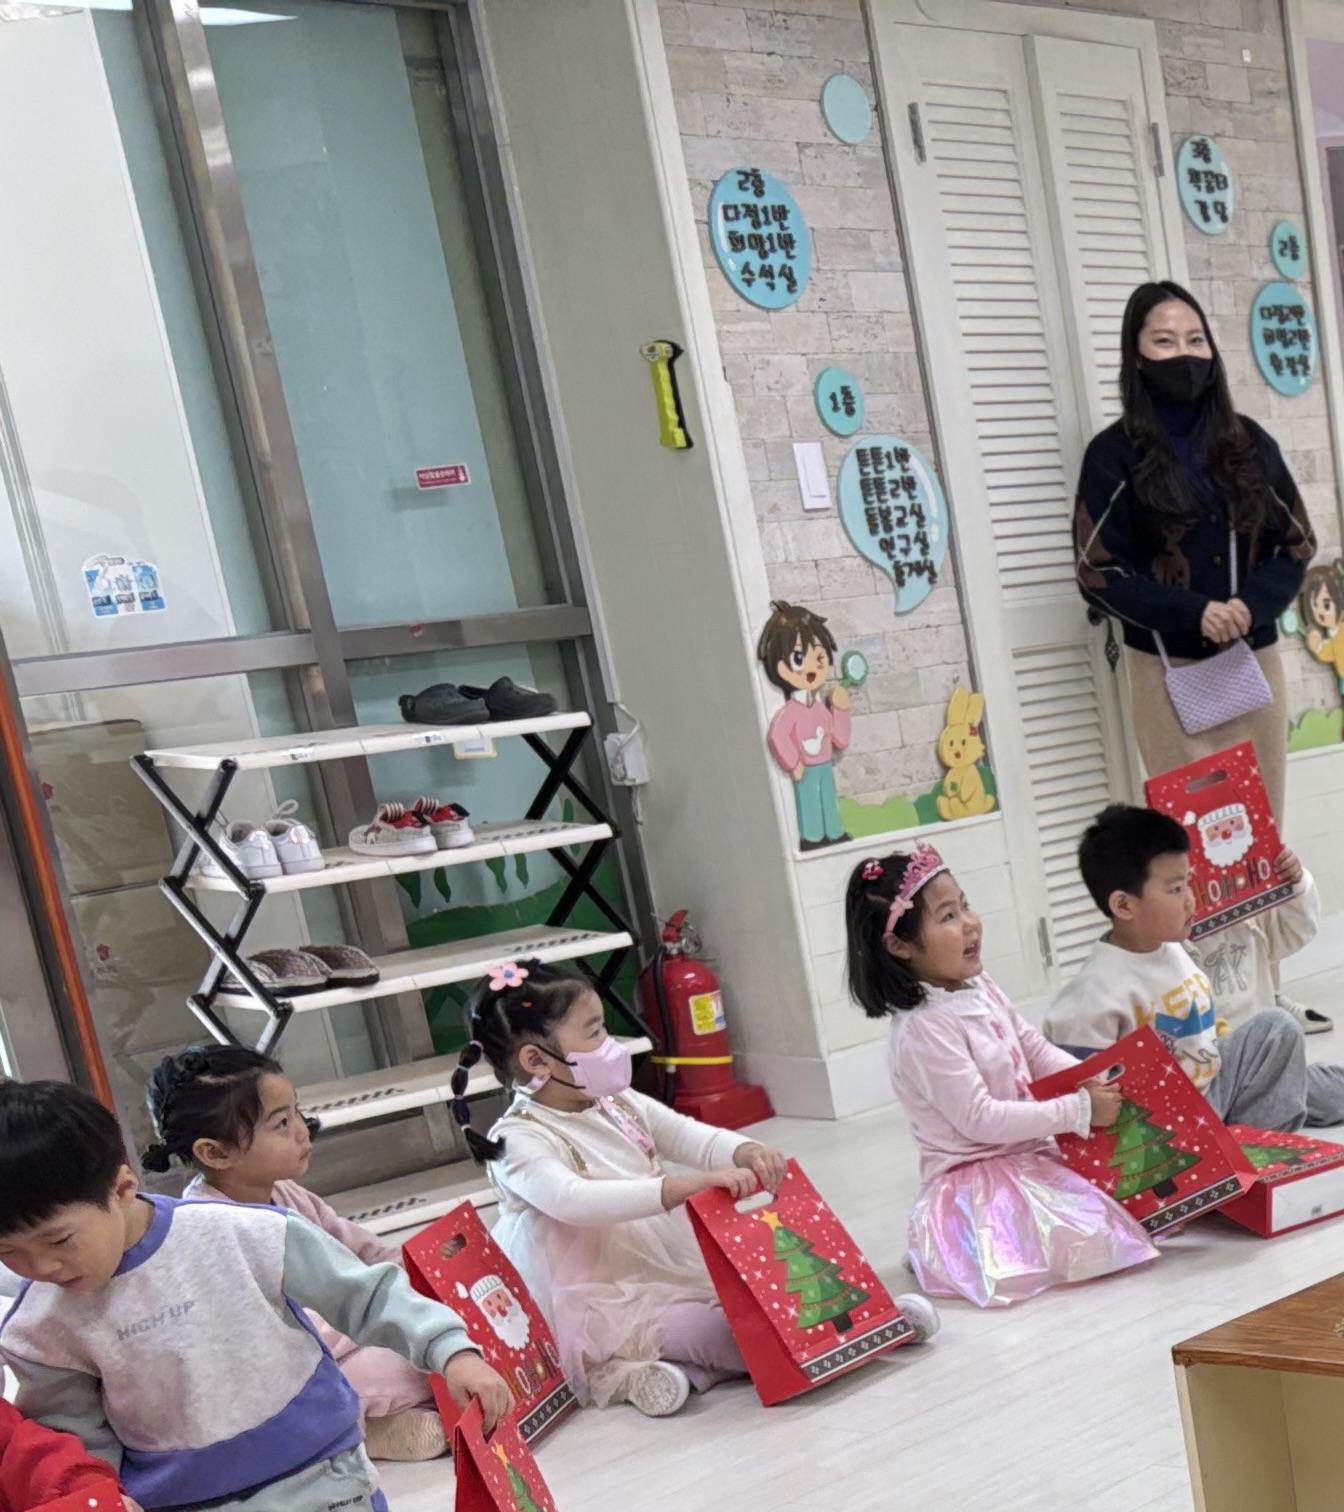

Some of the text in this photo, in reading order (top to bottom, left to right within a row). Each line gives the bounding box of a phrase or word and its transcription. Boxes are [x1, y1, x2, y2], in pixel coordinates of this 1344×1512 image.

[736, 168, 766, 198] 2층
[722, 203, 790, 232] 다정1반
[829, 385, 856, 417] 1층
